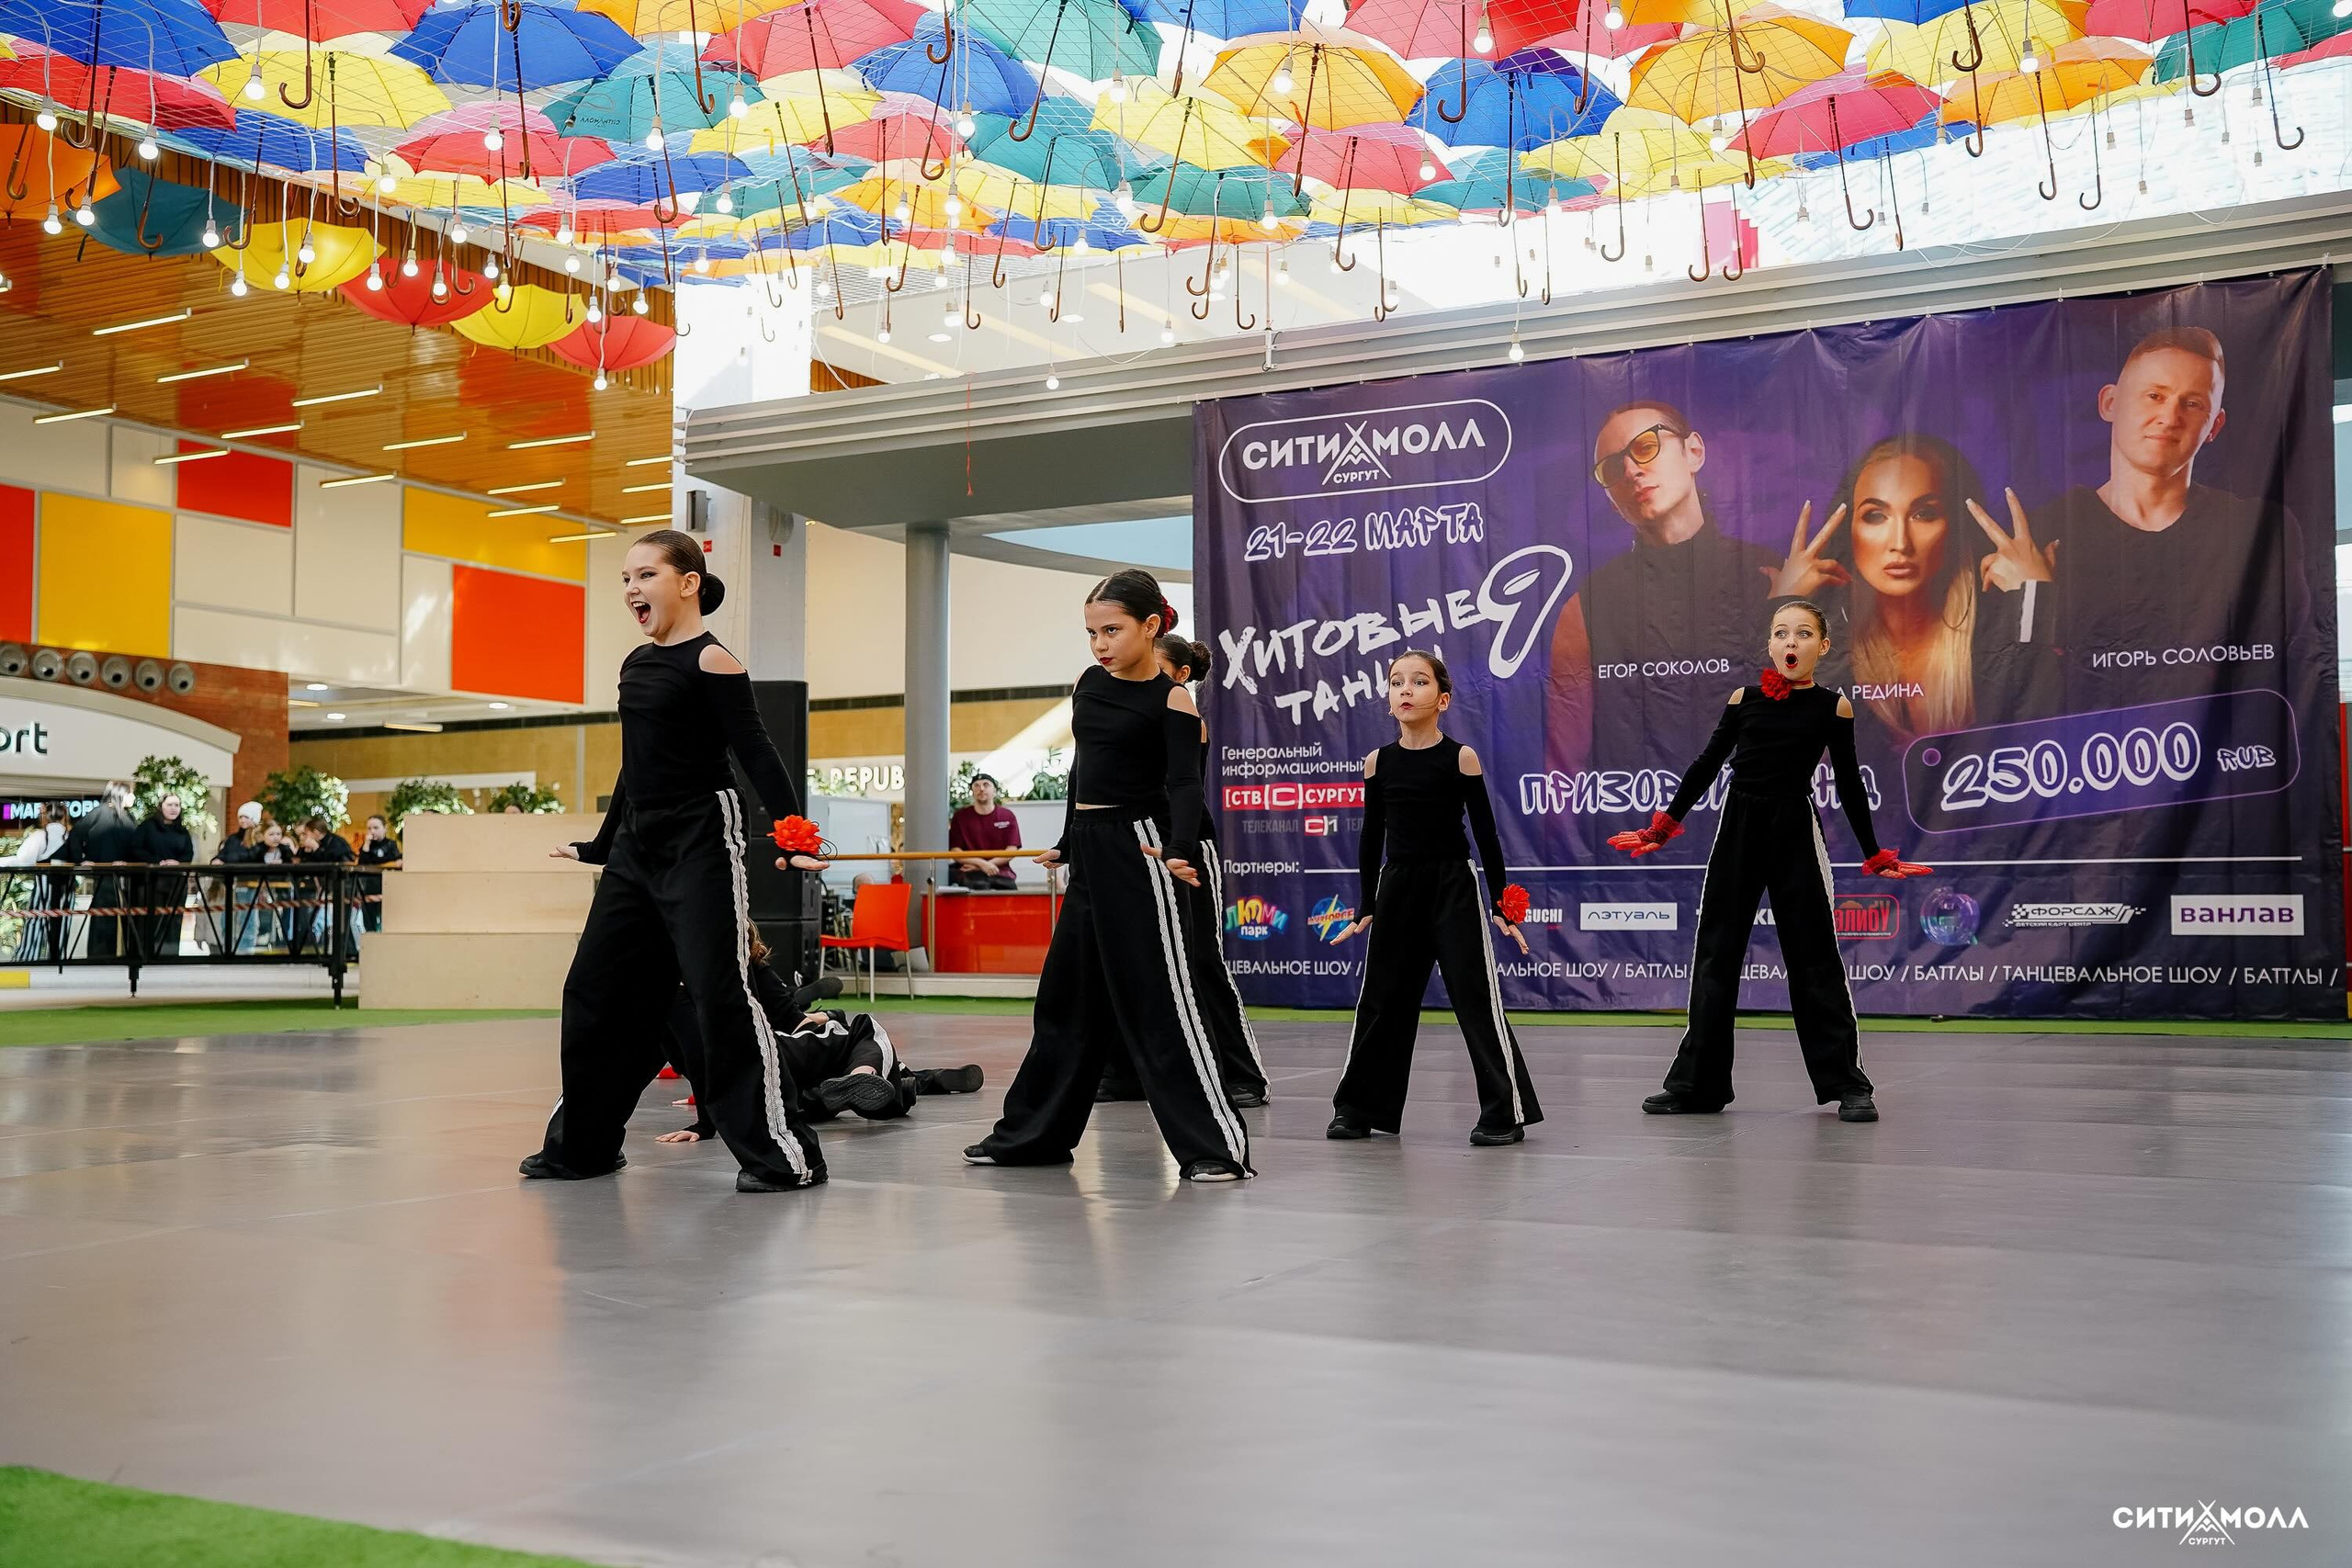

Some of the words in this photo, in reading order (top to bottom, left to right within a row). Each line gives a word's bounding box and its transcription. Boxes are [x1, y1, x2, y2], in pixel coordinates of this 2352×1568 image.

[1242, 433, 1340, 469] СИТИ
[1373, 418, 1486, 456] МОЛЛ
[1332, 469, 1380, 484] СУРГУТ
[1244, 517, 1357, 562] 21-22
[1364, 502, 1484, 551] МАРТА
[1218, 590, 1482, 695] ХИТОВЫЕ
[2092, 650, 2157, 668] ИГОРЬ
[2162, 644, 2275, 665] СОЛОВЬЕВ
[1598, 662, 1637, 679] ЕГОР
[1642, 658, 1730, 677] СОКОЛОВ
[1852, 682, 1924, 701] РЕДИНА
[1222, 742, 1322, 761] Генеральный
[1940, 721, 2201, 811] 250.000
[2217, 745, 2277, 772] RUB
[1224, 860, 1300, 876] Партнеры:
[2031, 907, 2117, 916] ФОРСАЖ
[2180, 907, 2295, 923] ванлав
[1240, 925, 1269, 938] парк
[1314, 960, 1351, 976] ШОУ
[1566, 962, 1609, 977] ШОУ
[1624, 963, 1688, 979] БАТТЛЫ
[1849, 964, 1896, 980] ШОУ
[1915, 965, 1984, 981] БАТТЛЫ
[2002, 965, 2163, 984] ТАНЦЕВАЛЬНОЕ
[2168, 966, 2222, 985] ШОУ
[2244, 967, 2323, 985] БАТТЛЫ
